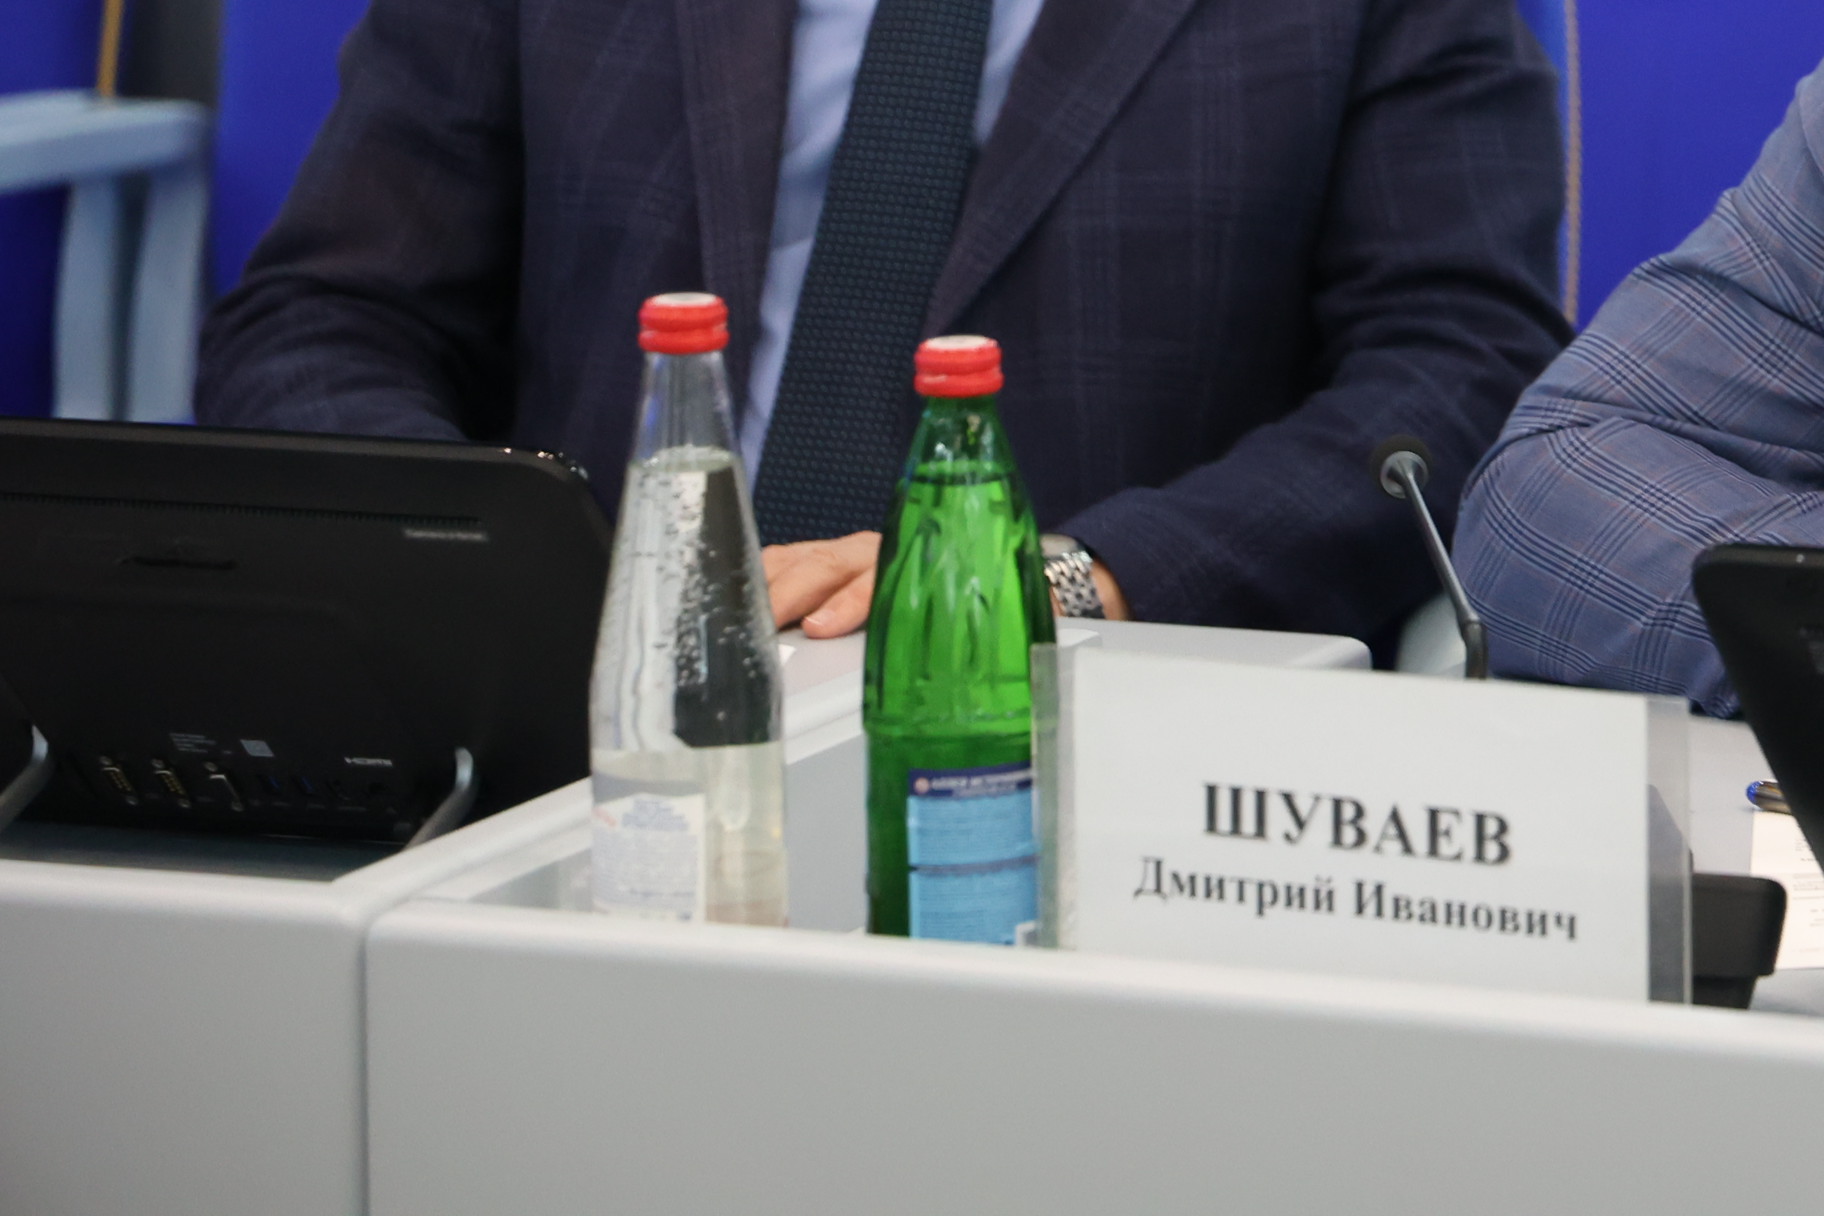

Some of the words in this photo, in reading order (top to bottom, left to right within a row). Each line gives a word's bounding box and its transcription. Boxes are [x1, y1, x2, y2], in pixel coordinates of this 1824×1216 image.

[1202, 782, 1513, 866] ШУВАЕВ
[1133, 856, 1336, 918] Дмитрий
[1353, 880, 1578, 941] Иванович
